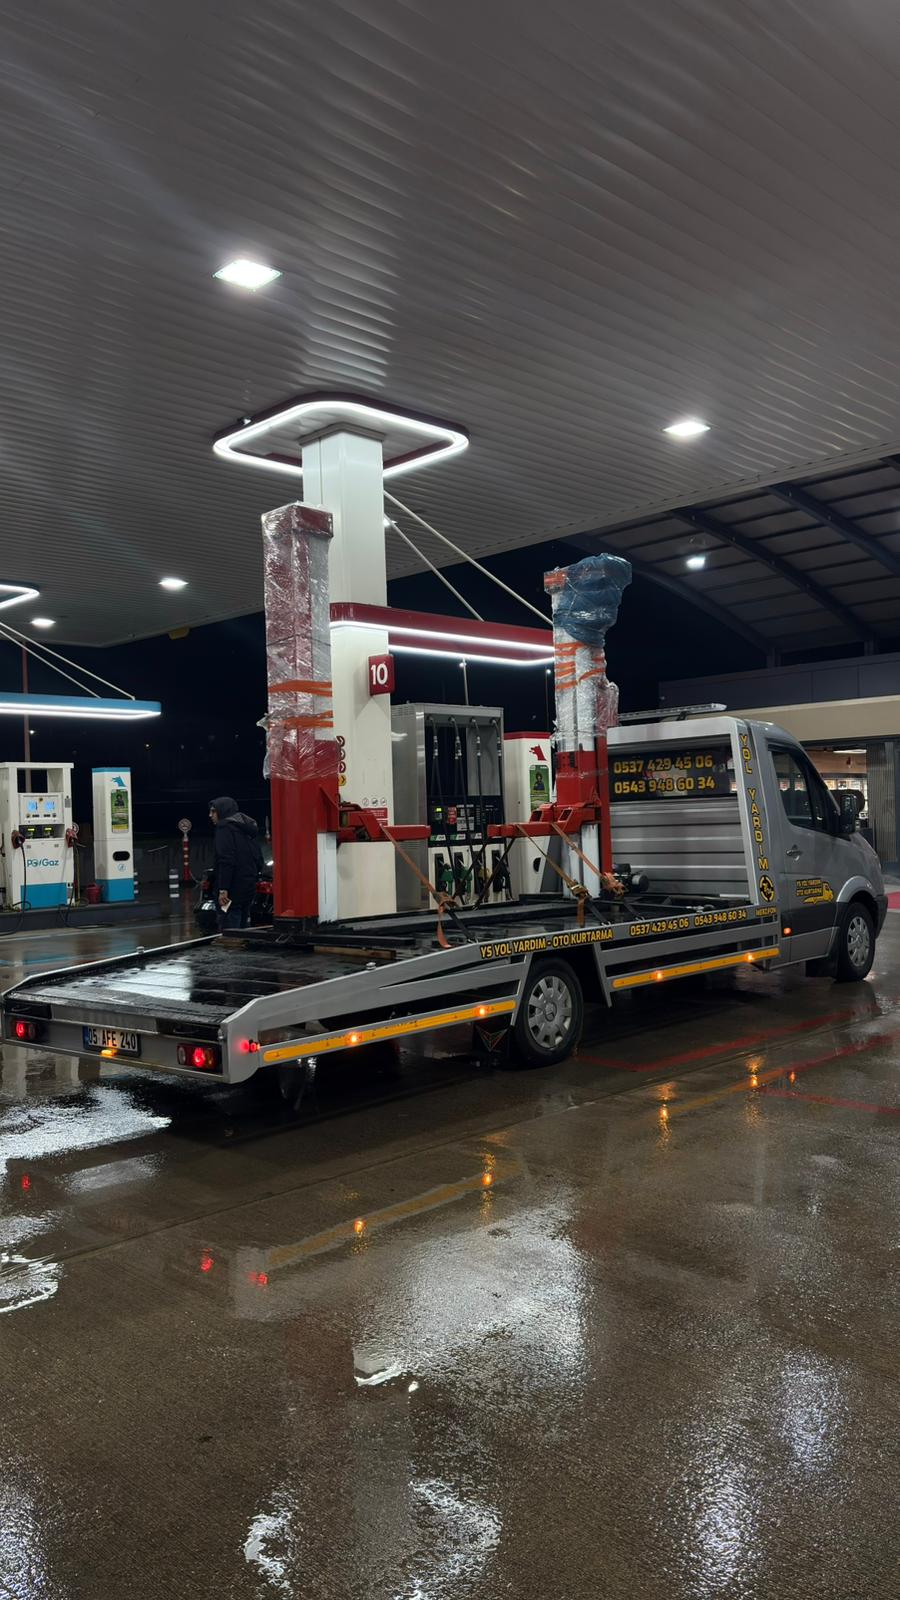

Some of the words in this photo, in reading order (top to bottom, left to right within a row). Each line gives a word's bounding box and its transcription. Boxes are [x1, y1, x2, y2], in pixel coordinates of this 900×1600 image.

[370, 663, 388, 685] 10
[613, 761, 644, 775] 0537
[647, 758, 672, 772] 429
[675, 756, 692, 769] 45
[695, 755, 713, 768] 06
[614, 781, 646, 794] 0543
[649, 779, 673, 792] 948
[677, 777, 694, 790] 60
[697, 776, 715, 789] 34
[740, 735, 752, 774] YOL
[748, 789, 769, 870] YARDIM
[630, 924, 650, 936] 0537
[651, 921, 667, 933] 429
[667, 919, 678, 931] 45
[678, 918, 689, 929] 06
[694, 914, 712, 926] 0543
[713, 911, 727, 924] 948
[727, 910, 737, 922] 60
[737, 909, 747, 920] 34
[480, 945, 493, 958] YS
[494, 943, 512, 956] YOL
[513, 939, 546, 953] YARDIM
[552, 934, 570, 947] OTO
[570, 929, 613, 945] KURTARMA
[88, 1028, 98, 1044] 05
[102, 1030, 117, 1046] AFE
[120, 1032, 136, 1050] 240
